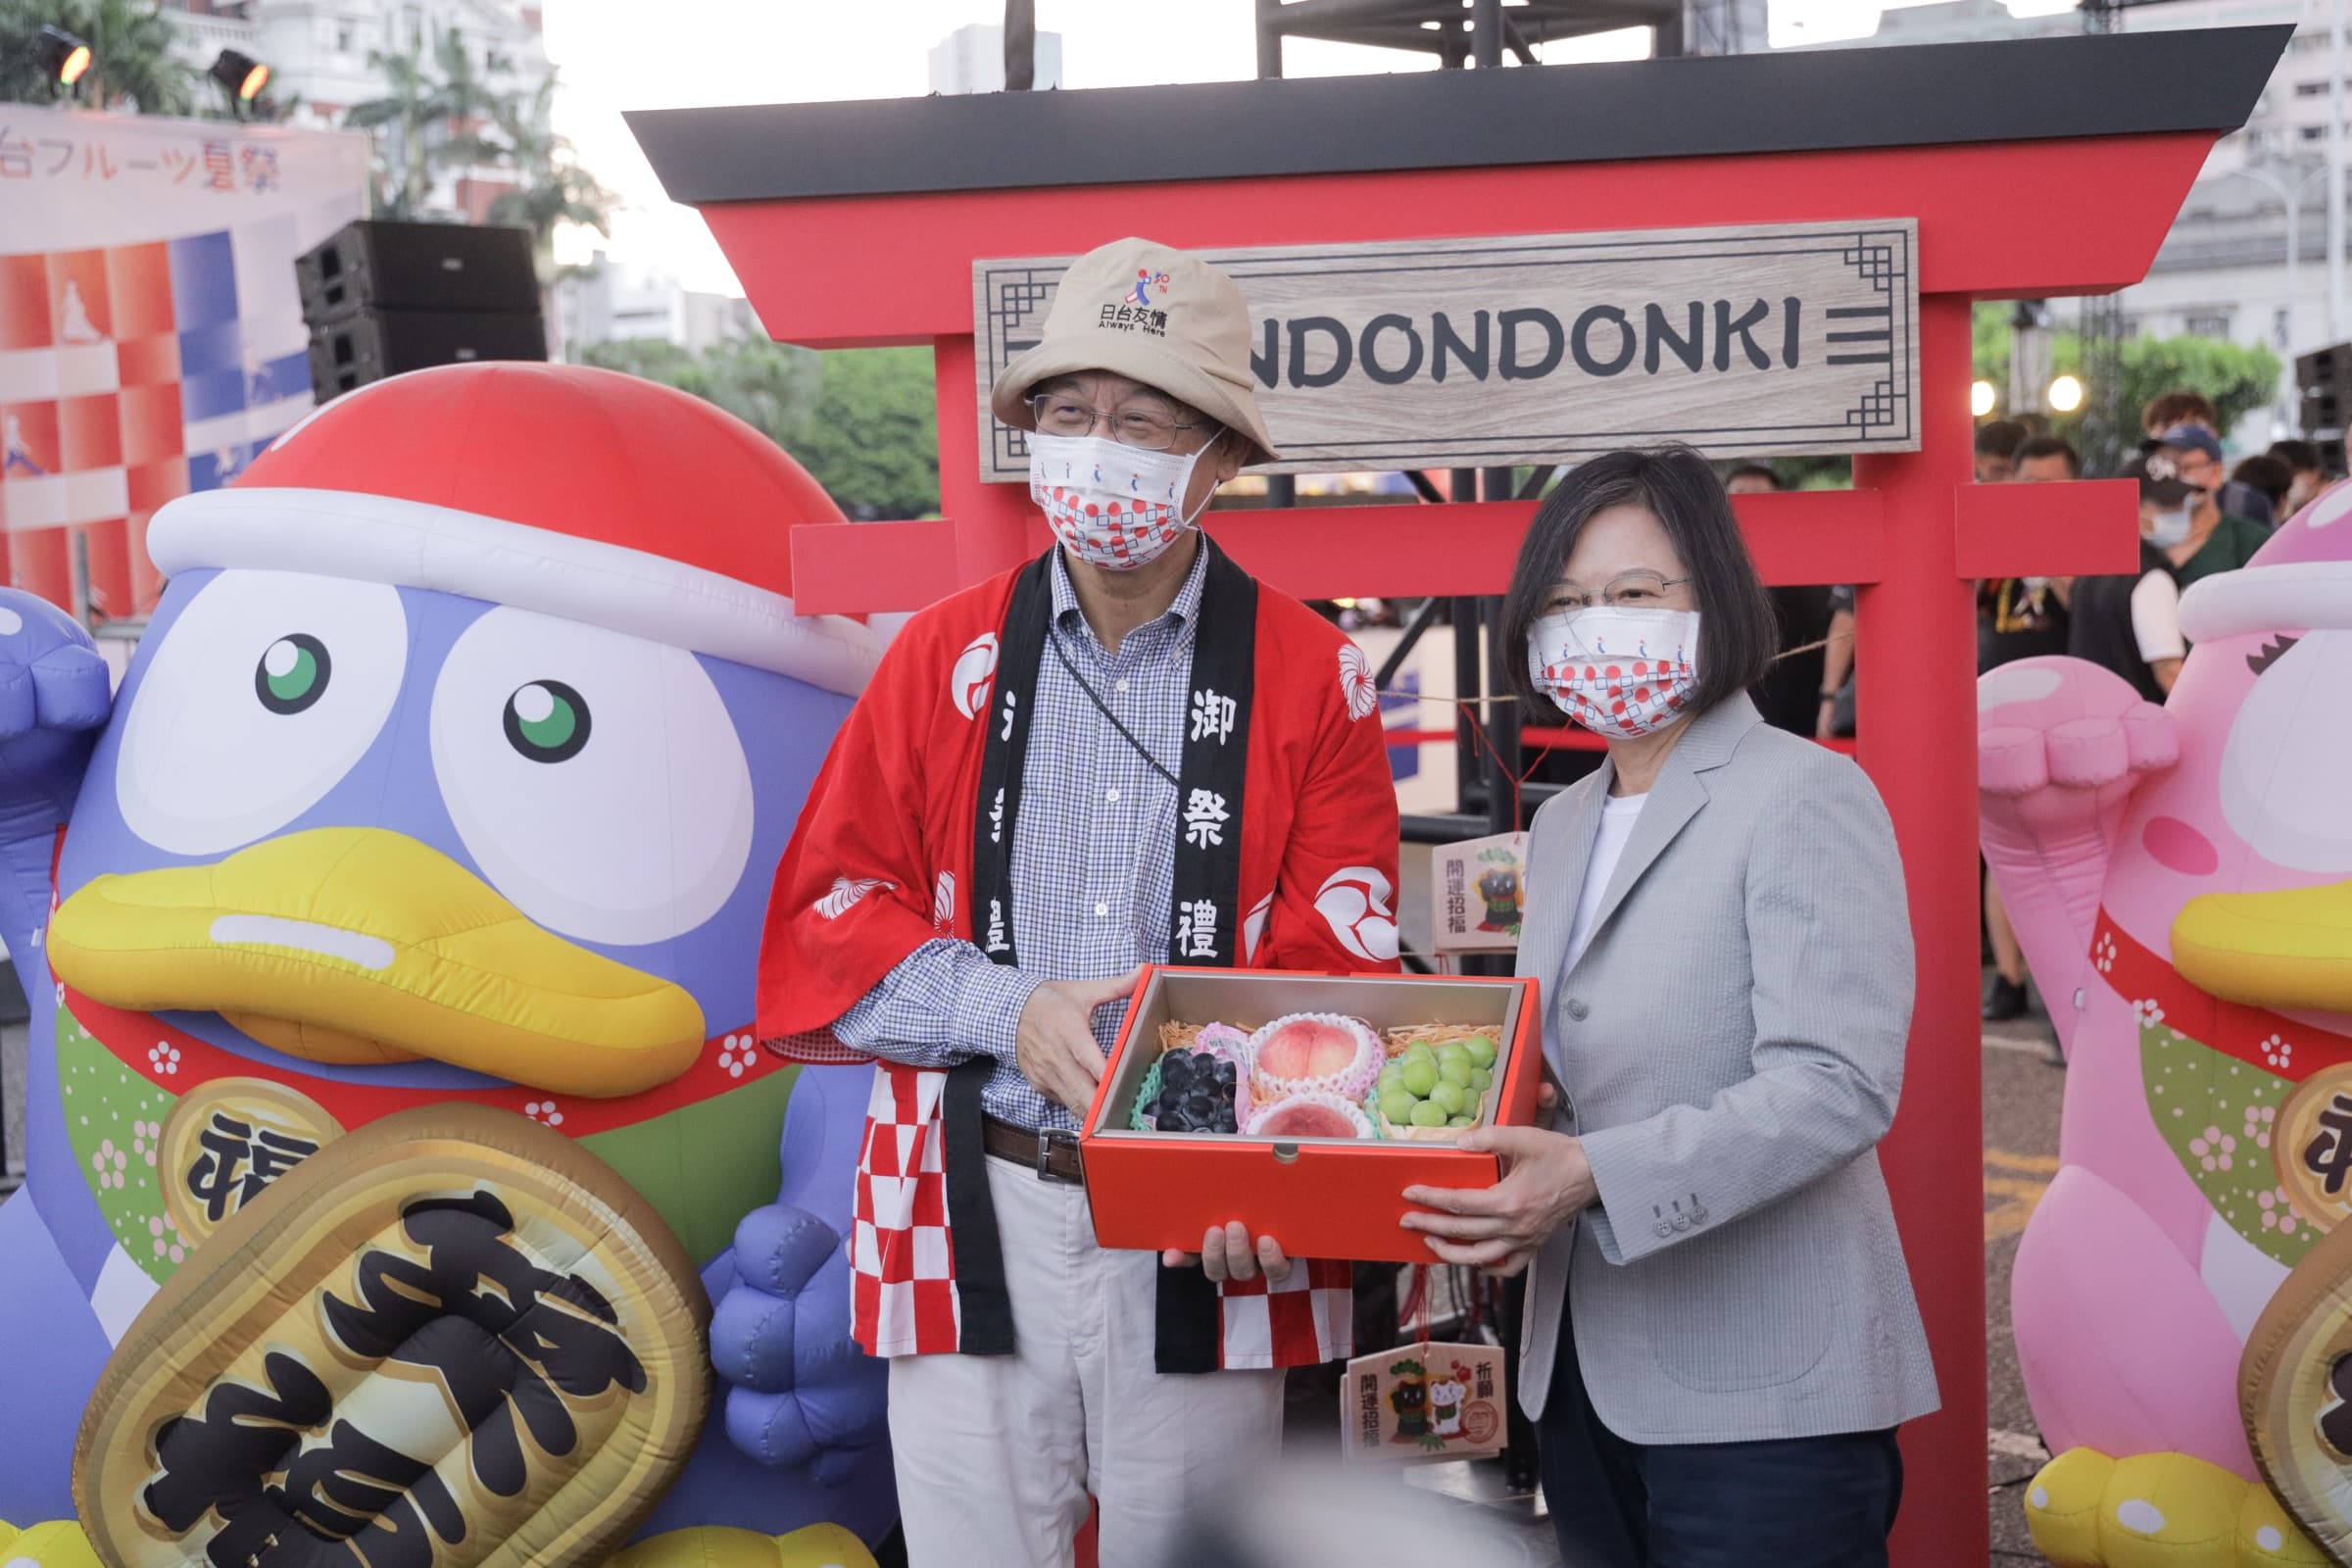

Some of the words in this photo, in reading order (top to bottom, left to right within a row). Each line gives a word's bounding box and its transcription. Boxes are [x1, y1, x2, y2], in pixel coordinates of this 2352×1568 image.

[1099, 321, 1134, 331] Always
[1143, 325, 1165, 337] Here
[1100, 304, 1168, 329] 日台友情
[1446, 858, 1467, 934] 開運招福
[1476, 1360, 1494, 1399] 祈願
